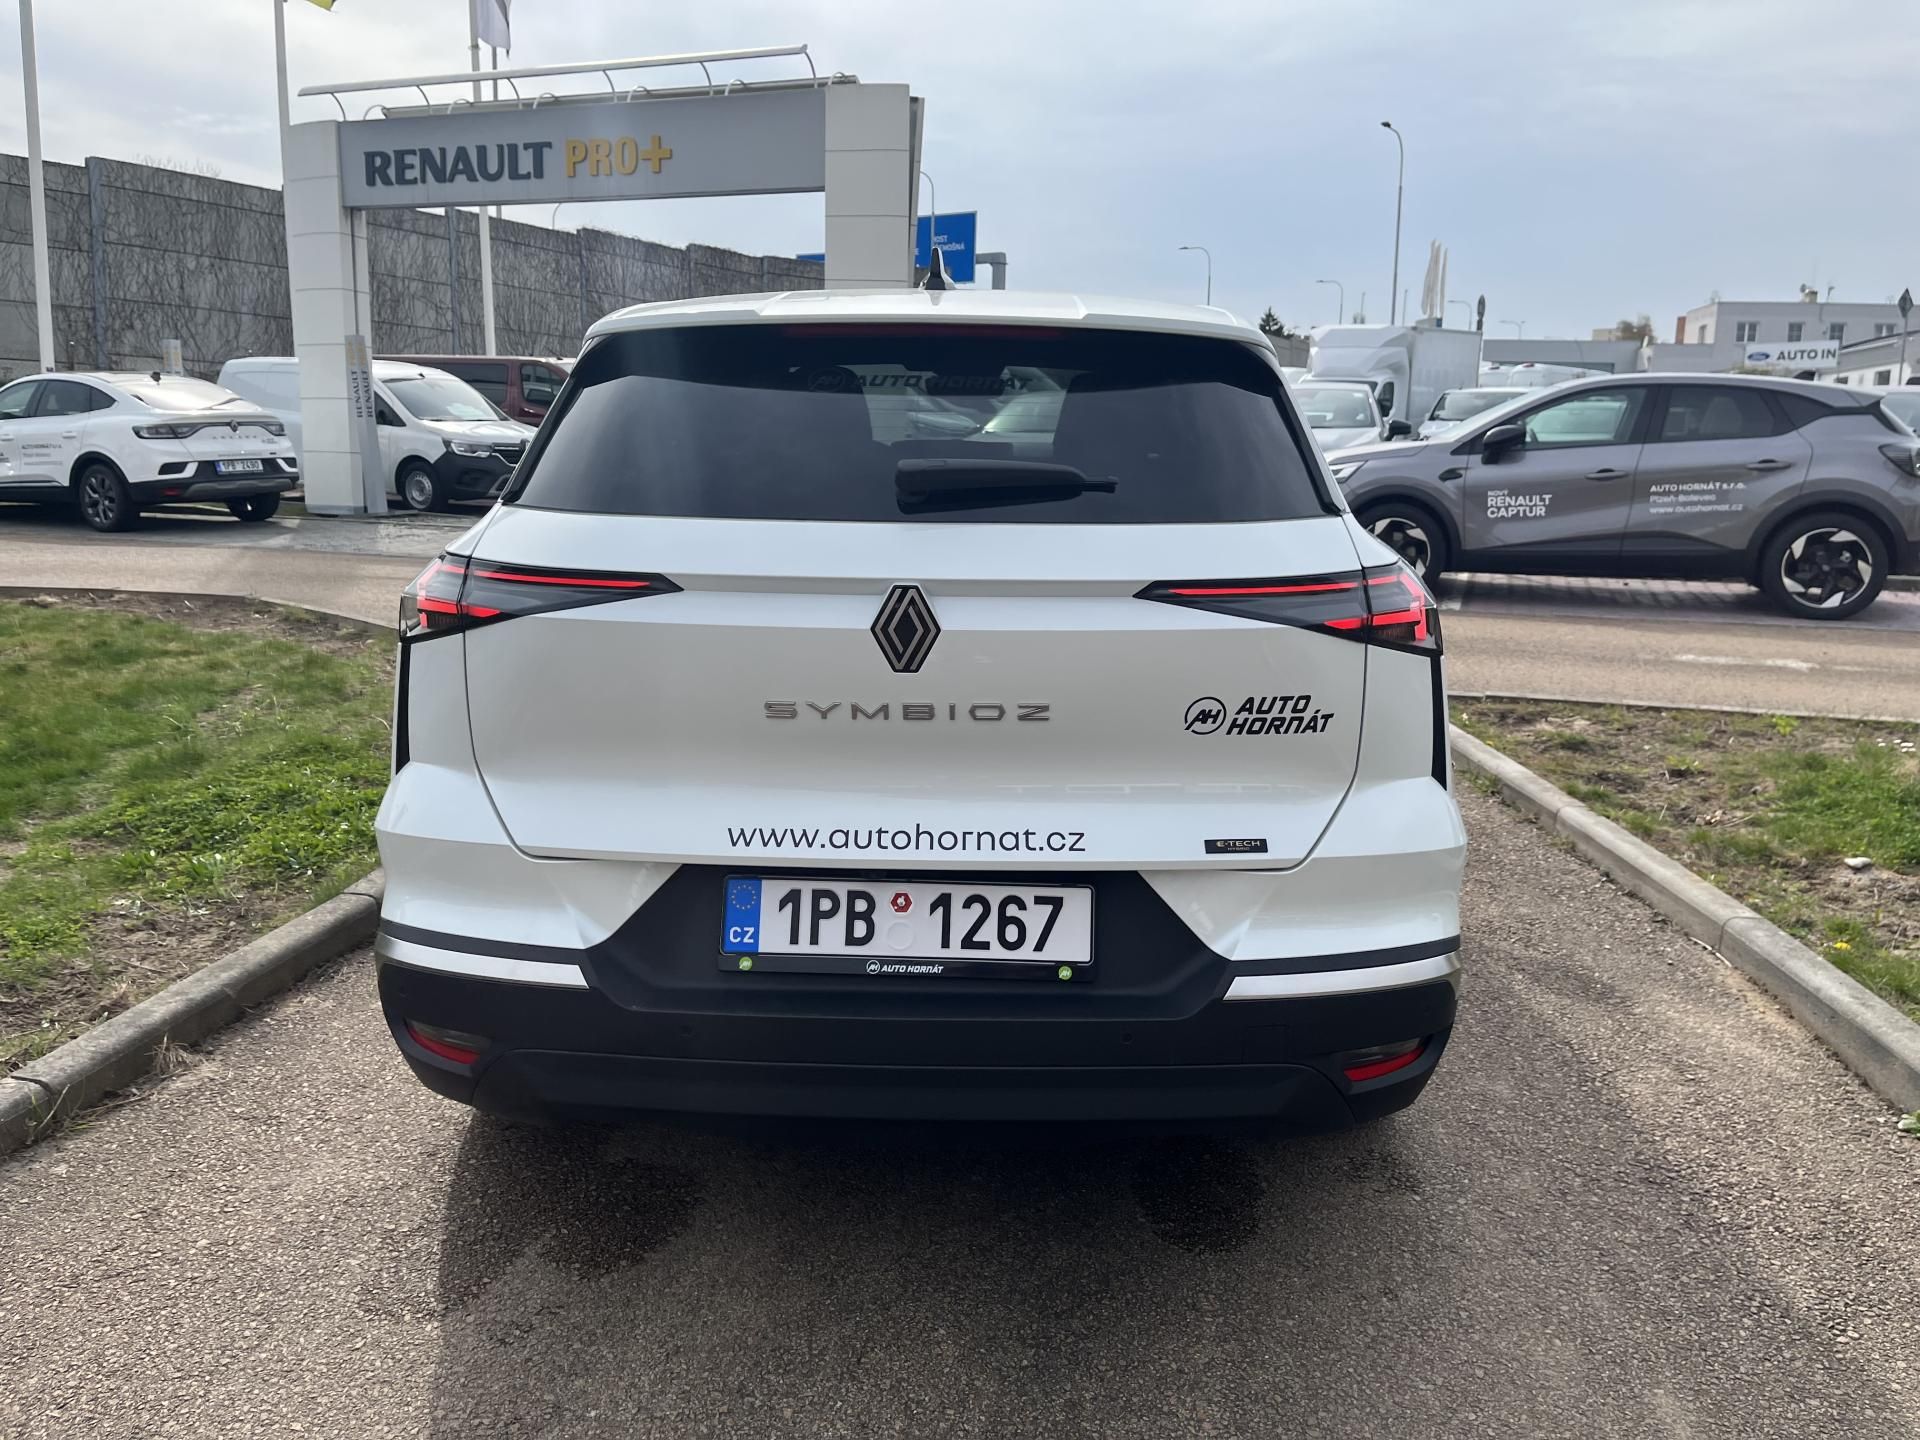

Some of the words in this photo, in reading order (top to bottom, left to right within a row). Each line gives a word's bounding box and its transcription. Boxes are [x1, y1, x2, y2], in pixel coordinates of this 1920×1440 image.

[363, 141, 553, 187] RENAULT
[564, 134, 673, 178] PRO+
[1776, 349, 1818, 361] AUTO
[1820, 348, 1837, 359] IN
[856, 374, 923, 388] AUTO
[351, 370, 363, 418] RENAULT
[361, 370, 374, 418] RENAULT
[1650, 484, 1678, 492] AUTO
[1679, 481, 1721, 491] HORNÁT
[1487, 494, 1553, 507] RENAULT
[1487, 506, 1546, 518] CAPTUR
[764, 700, 1050, 721] SYMBIOZ
[1234, 695, 1312, 715] AUTO
[1225, 709, 1335, 735] HORNÁT
[727, 823, 1086, 852] www.autohornat.cz
[778, 888, 877, 947] 1PB
[929, 892, 1065, 952] 1267
[729, 926, 755, 943] CZ
[881, 964, 907, 973] AUTO
[907, 964, 944, 974] HORNÁT
